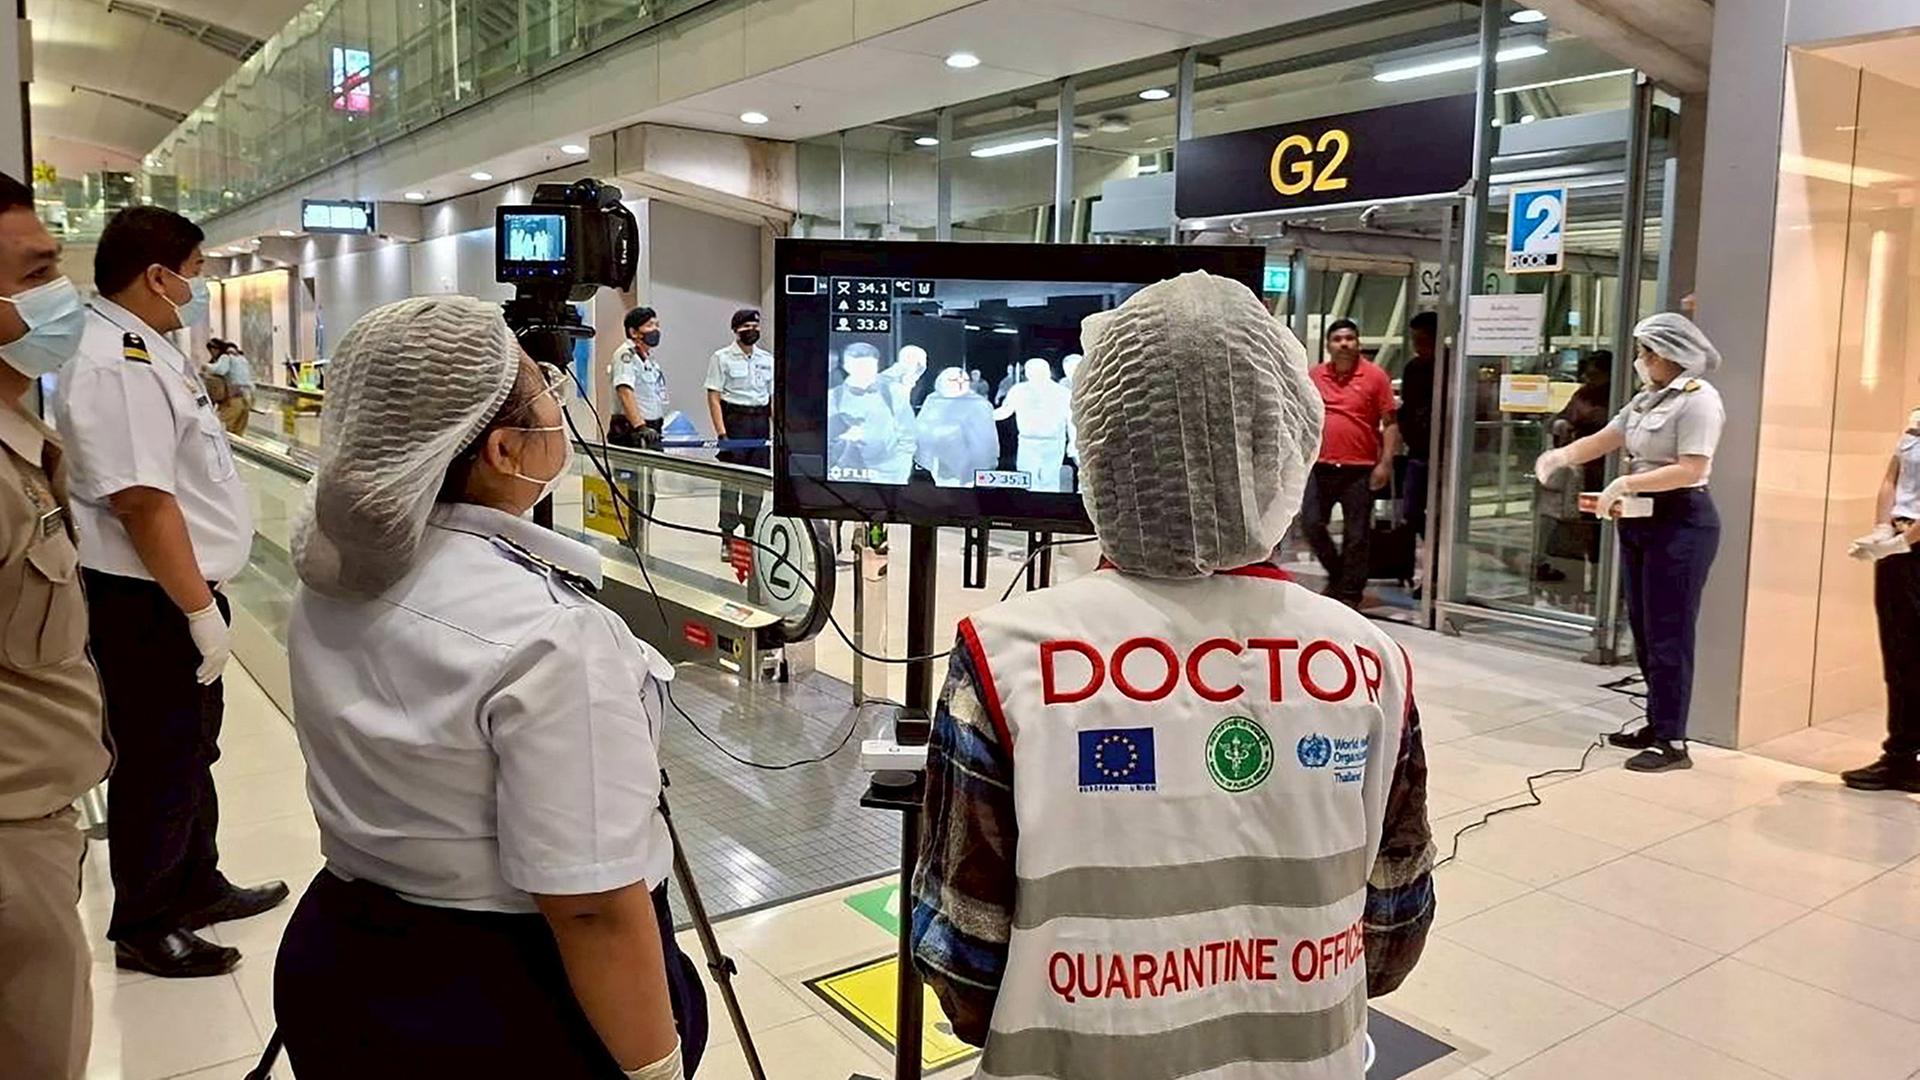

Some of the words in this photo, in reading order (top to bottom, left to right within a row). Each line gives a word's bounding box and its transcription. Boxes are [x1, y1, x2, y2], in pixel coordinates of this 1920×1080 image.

[1270, 129, 1349, 196] G2
[1524, 194, 1561, 251] 2
[857, 283, 888, 294] 34.1
[857, 300, 888, 311] 35.1
[857, 319, 888, 331] 33.8
[770, 524, 790, 589] 2
[1039, 636, 1382, 703] DOCTOR
[1048, 938, 1279, 1003] QUARANTINE
